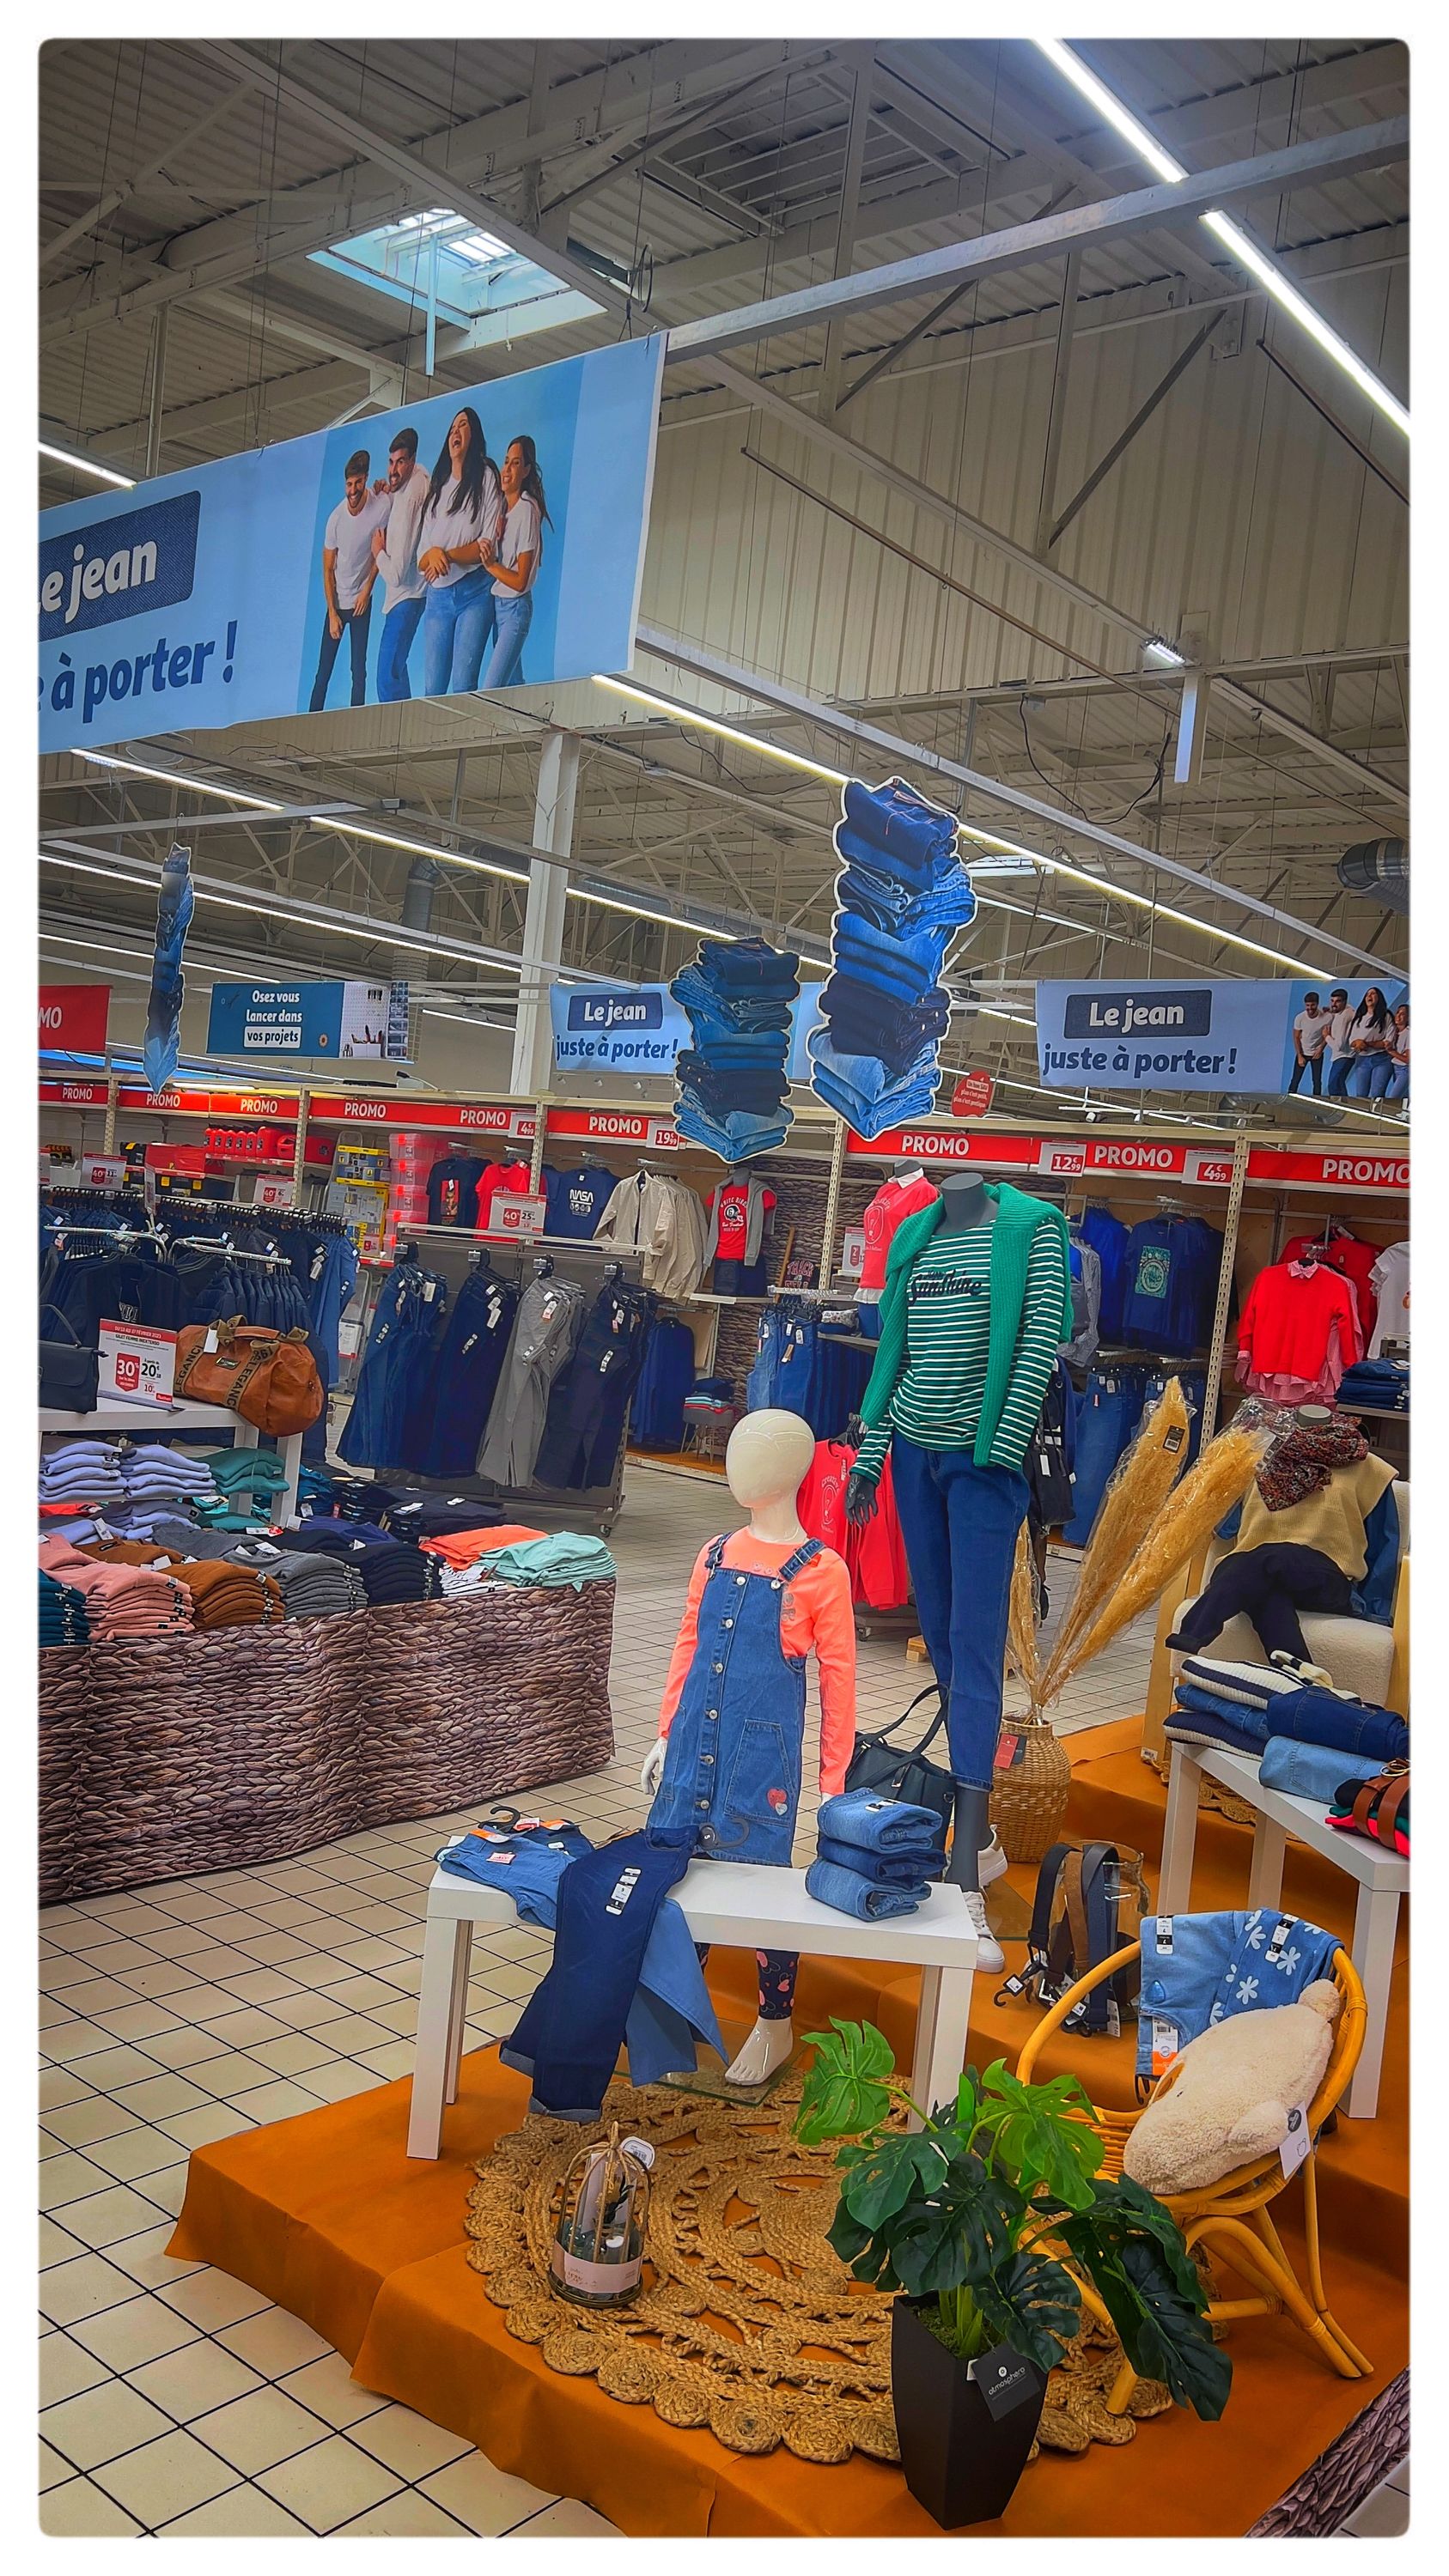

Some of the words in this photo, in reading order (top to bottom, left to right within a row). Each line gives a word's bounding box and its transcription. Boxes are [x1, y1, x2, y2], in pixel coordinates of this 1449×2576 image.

[38, 570, 63, 613] e
[64, 543, 157, 623] jean
[51, 651, 75, 712] à
[252, 989, 273, 1004] Osez
[273, 992, 301, 1004] vous
[246, 1008, 277, 1023] lancer
[277, 1008, 302, 1023] dans
[584, 1001, 605, 1022] Le
[604, 999, 647, 1027] jean
[1089, 1002, 1119, 1027] Le
[1121, 999, 1184, 1034] jean
[247, 1031, 264, 1042] vos
[265, 1029, 299, 1045] projets
[557, 1035, 595, 1061] juste
[598, 1036, 610, 1057] à
[1043, 1042, 1108, 1076] juste
[1112, 1044, 1129, 1071] à
[62, 1087, 93, 1100] PROMO
[146, 1093, 181, 1108] PROMO
[240, 1099, 278, 1114] PROMO
[344, 1103, 387, 1118] PROMO
[460, 1109, 507, 1126] PROMO
[588, 1116, 642, 1135] PROMO
[901, 1134, 970, 1157] PROMO
[1093, 1145, 1173, 1168] PROMO
[1322, 1157, 1410, 1184] PROMO
[569, 1188, 594, 1203] NASA
